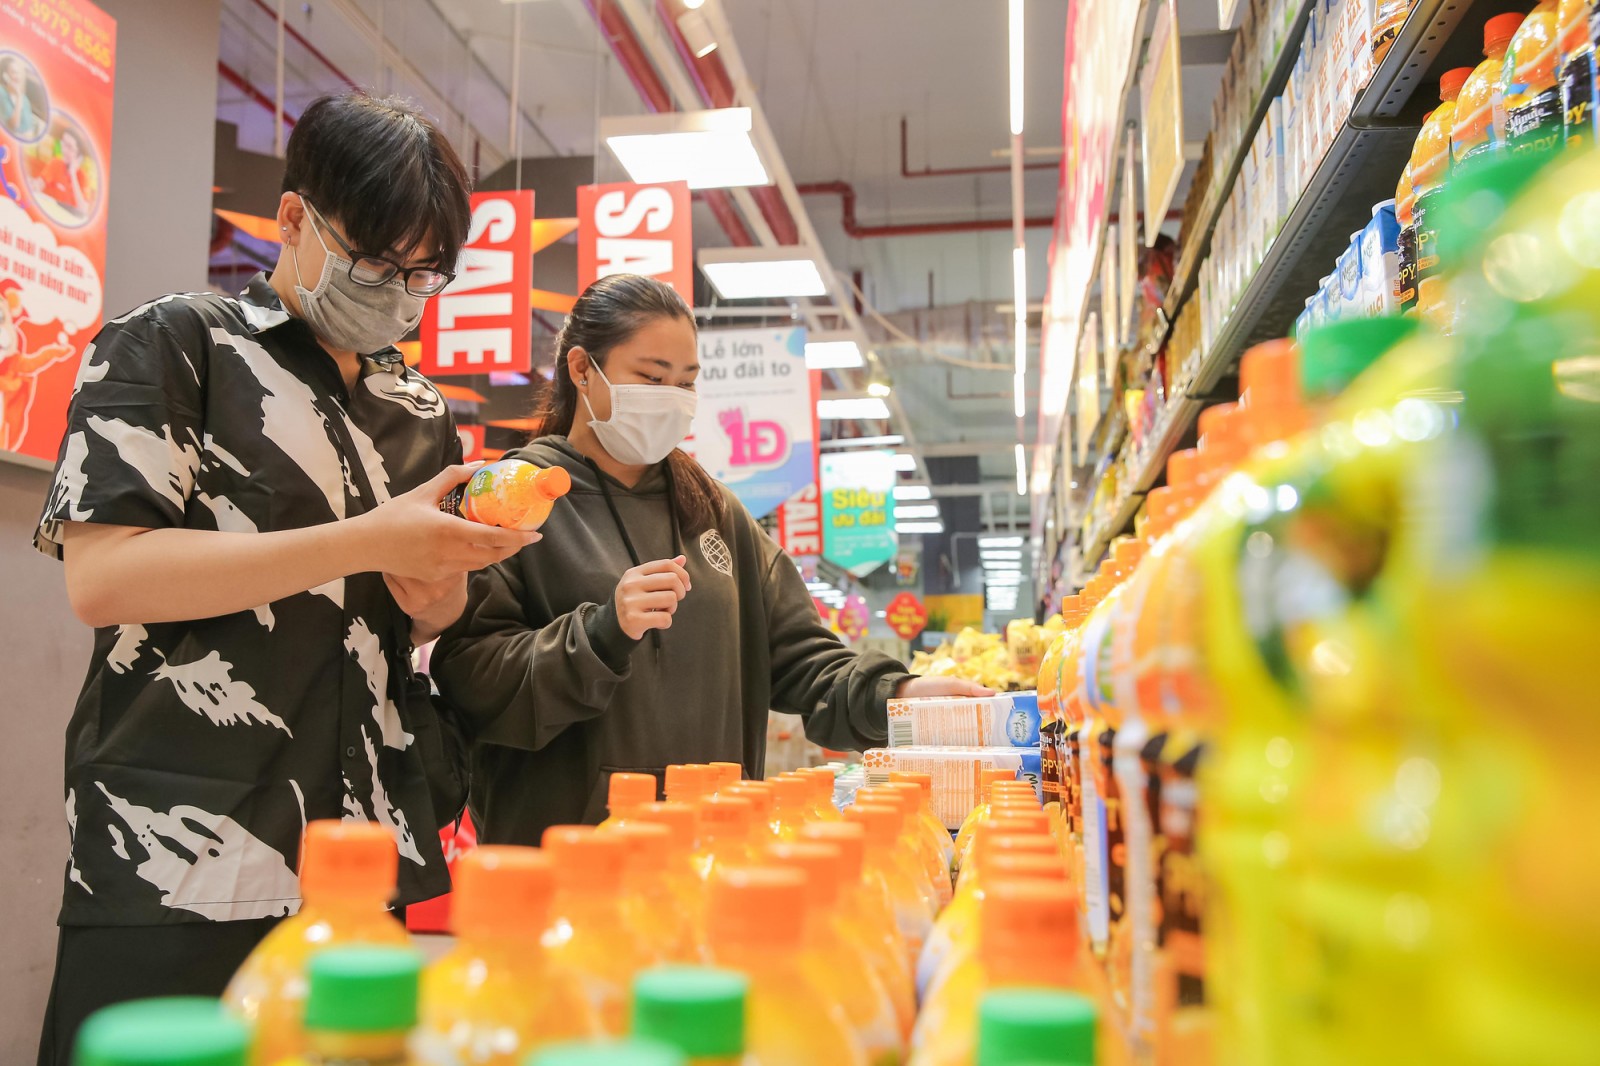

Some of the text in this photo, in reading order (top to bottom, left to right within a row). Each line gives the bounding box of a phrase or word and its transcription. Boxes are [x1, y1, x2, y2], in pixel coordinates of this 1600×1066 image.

[437, 199, 516, 368] SALE
[772, 361, 791, 377] to
[832, 487, 886, 510] Siêu
